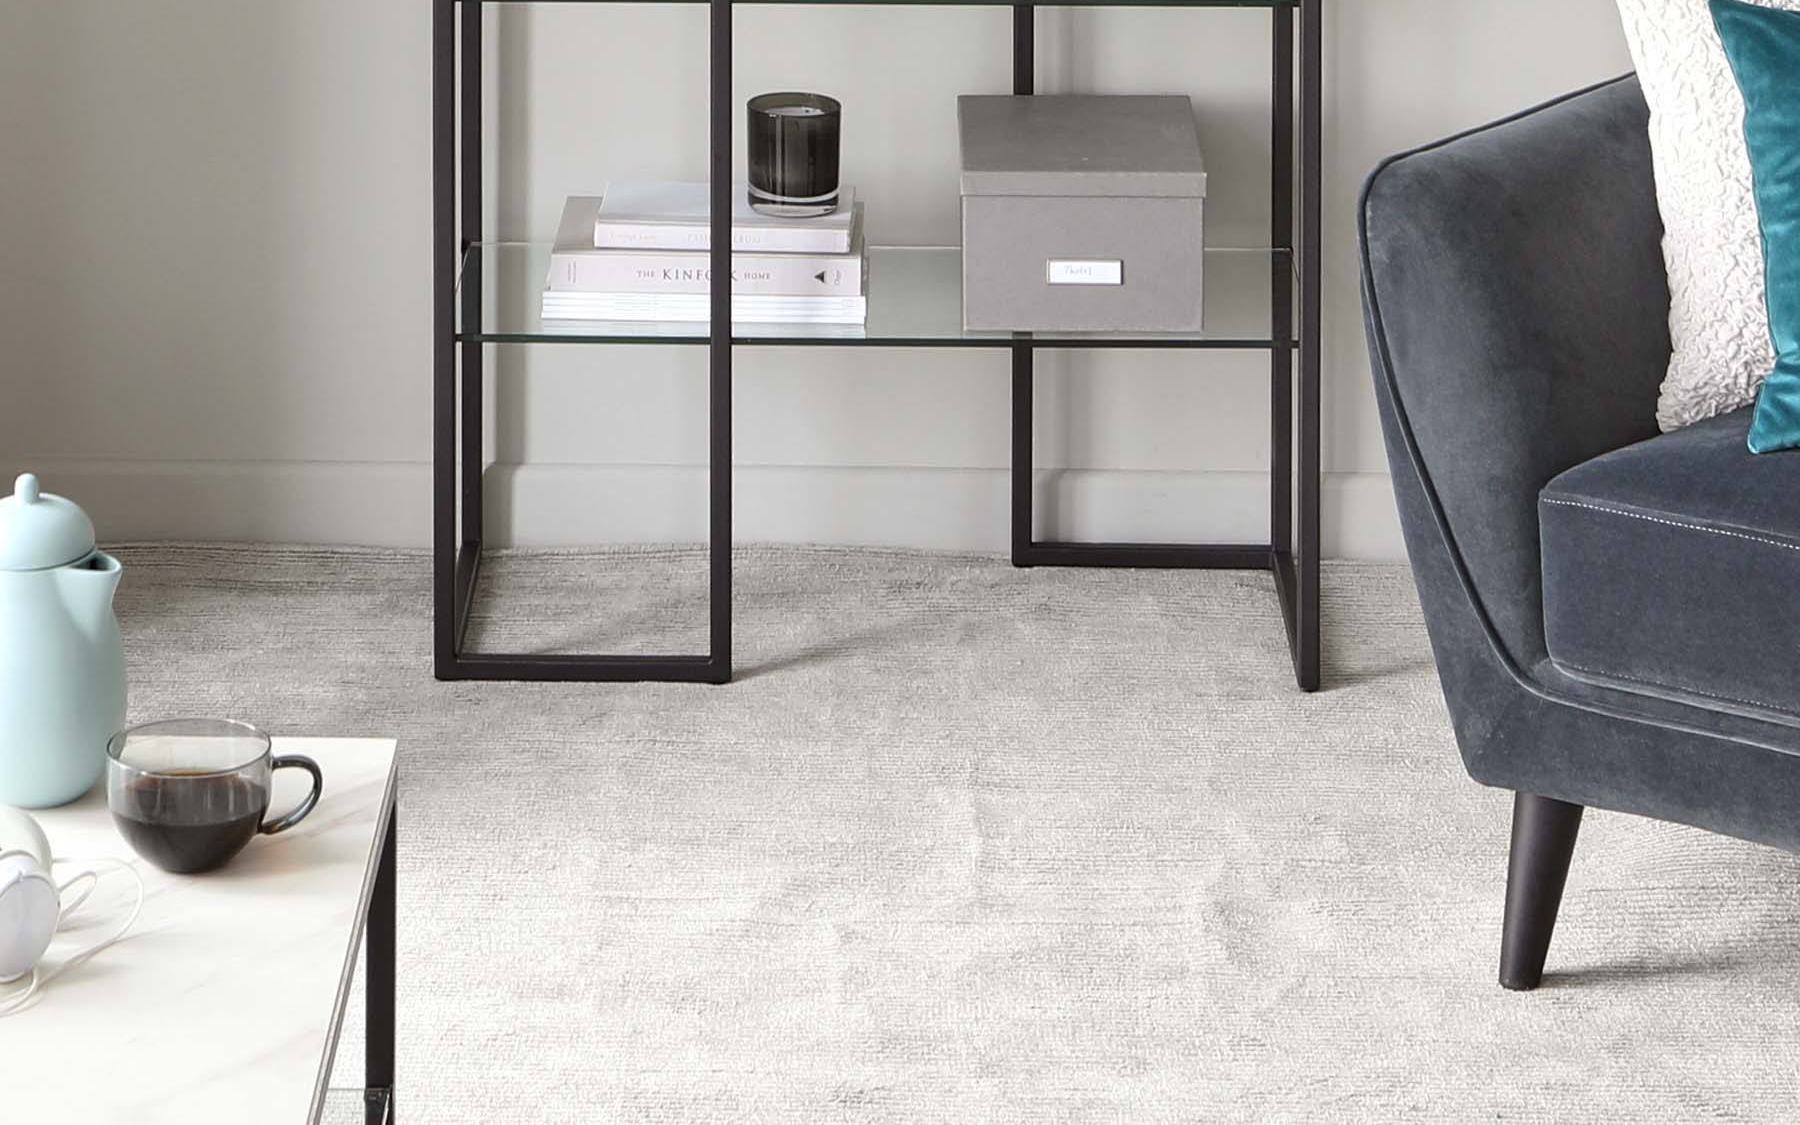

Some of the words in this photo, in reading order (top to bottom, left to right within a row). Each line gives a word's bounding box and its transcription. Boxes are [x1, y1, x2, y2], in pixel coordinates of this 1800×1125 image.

[637, 270, 655, 279] THE
[663, 268, 738, 281] KINFOK
[744, 272, 771, 280] HOME
